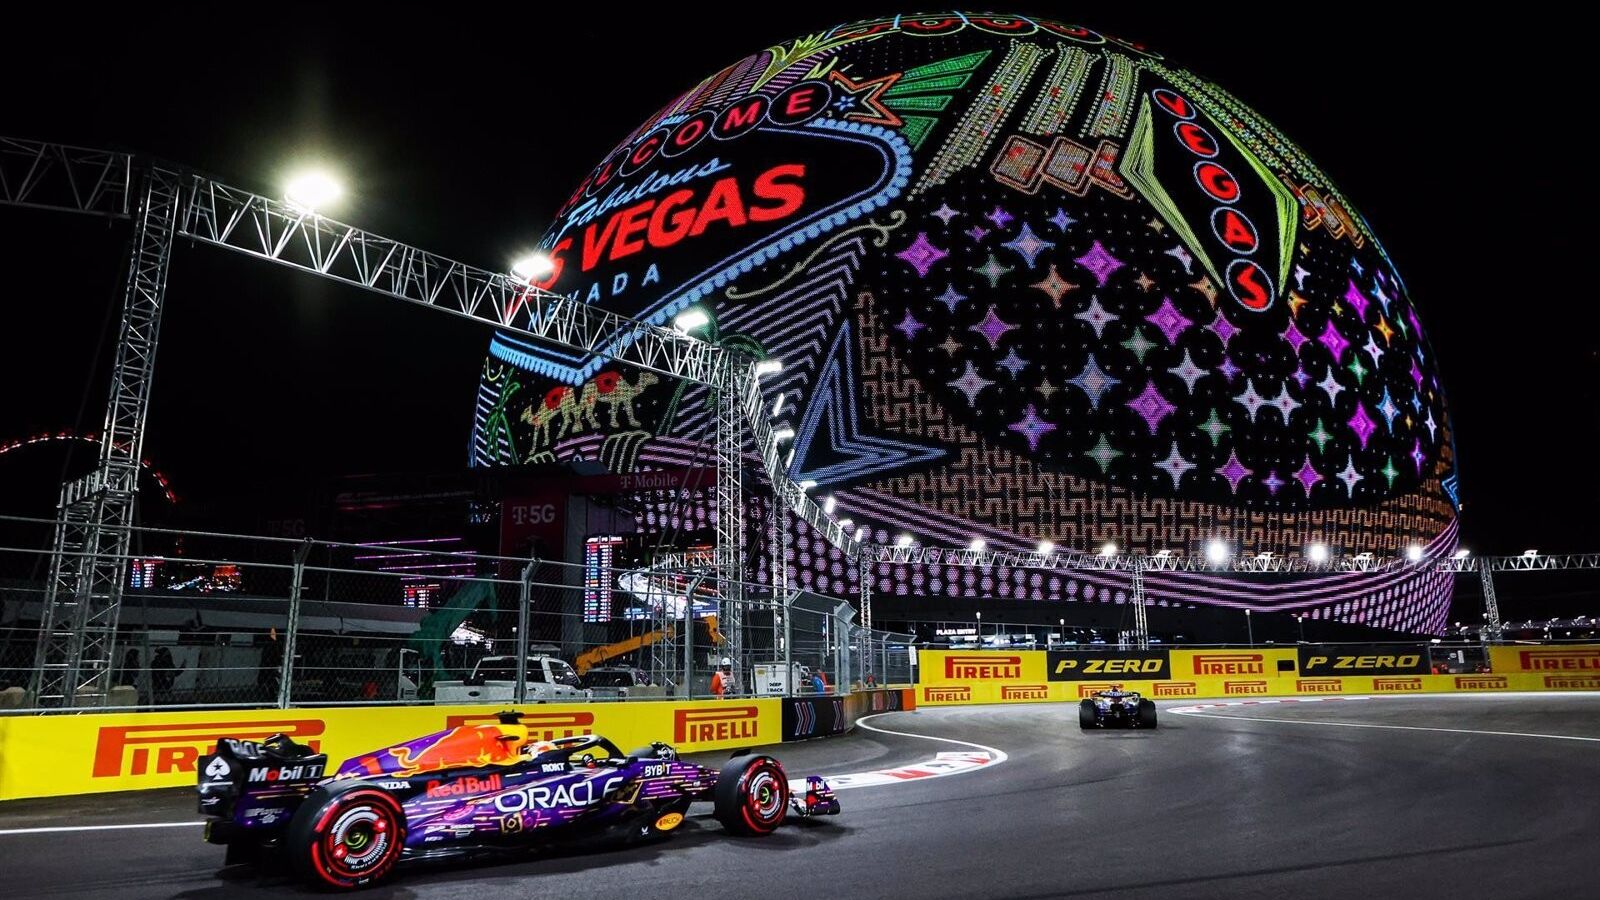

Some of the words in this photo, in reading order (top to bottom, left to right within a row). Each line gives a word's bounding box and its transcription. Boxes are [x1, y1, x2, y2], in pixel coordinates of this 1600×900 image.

[554, 87, 814, 218] ELCOME
[551, 157, 732, 249] Fabulous
[1156, 91, 1268, 311] VEGAS
[580, 163, 807, 272] VEGAS
[633, 474, 678, 488] Mobile
[529, 504, 556, 524] 5G
[945, 656, 1021, 678] PIRELLI
[1055, 659, 1078, 674] P
[1082, 658, 1163, 674] ZERO
[1193, 654, 1264, 675] PIRELLI
[1305, 655, 1328, 670] P
[1333, 654, 1421, 669] ZERO
[1153, 682, 1196, 696] PIRELLI
[1224, 681, 1267, 694] PIRELLI
[1296, 679, 1342, 693] PIRELLI
[1373, 678, 1422, 691] PIRELLI
[1455, 676, 1508, 690] PIRELLI
[924, 687, 971, 702] PIRELLI
[1001, 685, 1048, 700] PIRELLI
[674, 706, 758, 743] PIRELLI
[248, 765, 304, 783] Mobil
[541, 763, 565, 773] ROKT
[644, 762, 672, 777] BYBIT
[425, 779, 466, 798] Red
[466, 774, 502, 791] Bull
[494, 776, 624, 813] ORACLE
